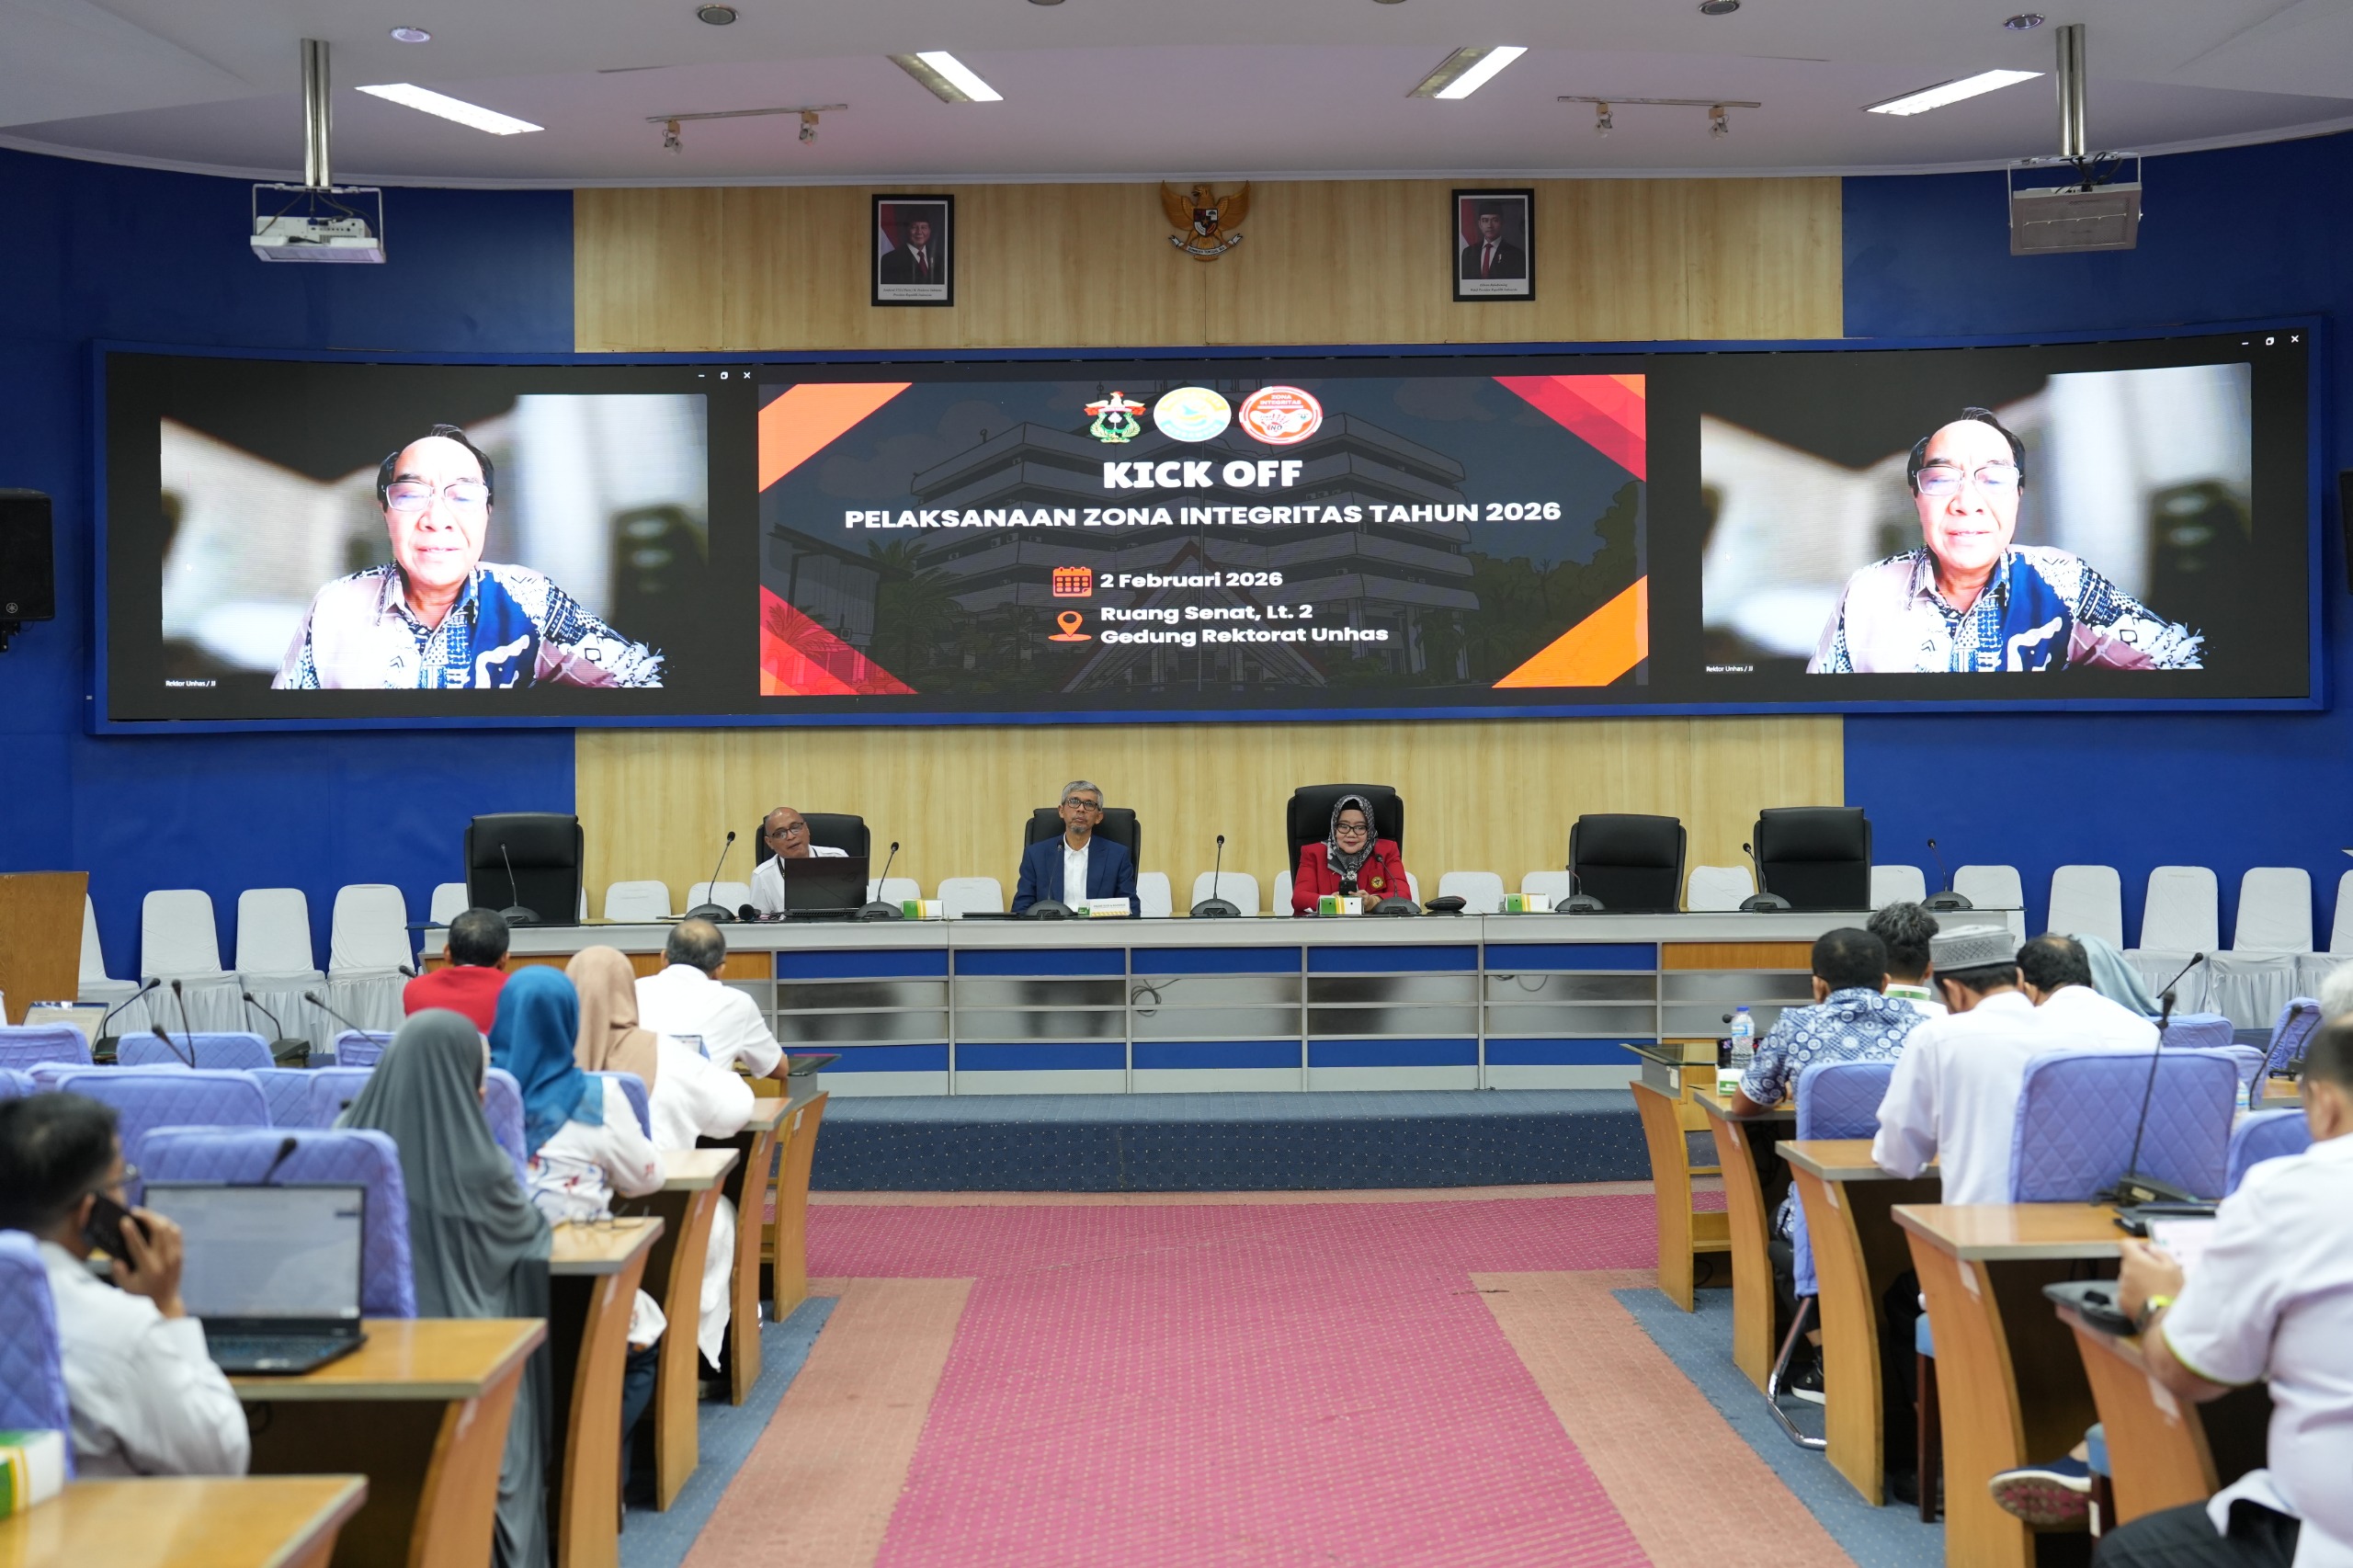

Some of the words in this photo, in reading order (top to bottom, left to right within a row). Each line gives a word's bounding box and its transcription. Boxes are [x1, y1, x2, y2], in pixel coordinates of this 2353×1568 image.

[1103, 460, 1214, 489] KICK
[1222, 460, 1303, 488] OFF
[845, 508, 1076, 528] PELAKSANAAN
[1083, 507, 1174, 527] ZONA
[1180, 505, 1363, 526] INTEGRITAS
[1368, 504, 1479, 523] TAHUN
[1485, 501, 1562, 522] 2026
[1099, 574, 1115, 588] 2
[1119, 571, 1222, 588] Februari
[1225, 572, 1283, 587] 2026
[1100, 607, 1179, 625] Ruang
[1184, 605, 1262, 623] Senat,
[1267, 605, 1294, 619] Lt.
[1299, 604, 1313, 619] 2
[1100, 629, 1197, 648] Gedung
[1201, 628, 1307, 643] Rektorat
[1311, 626, 1389, 642] Unhas
